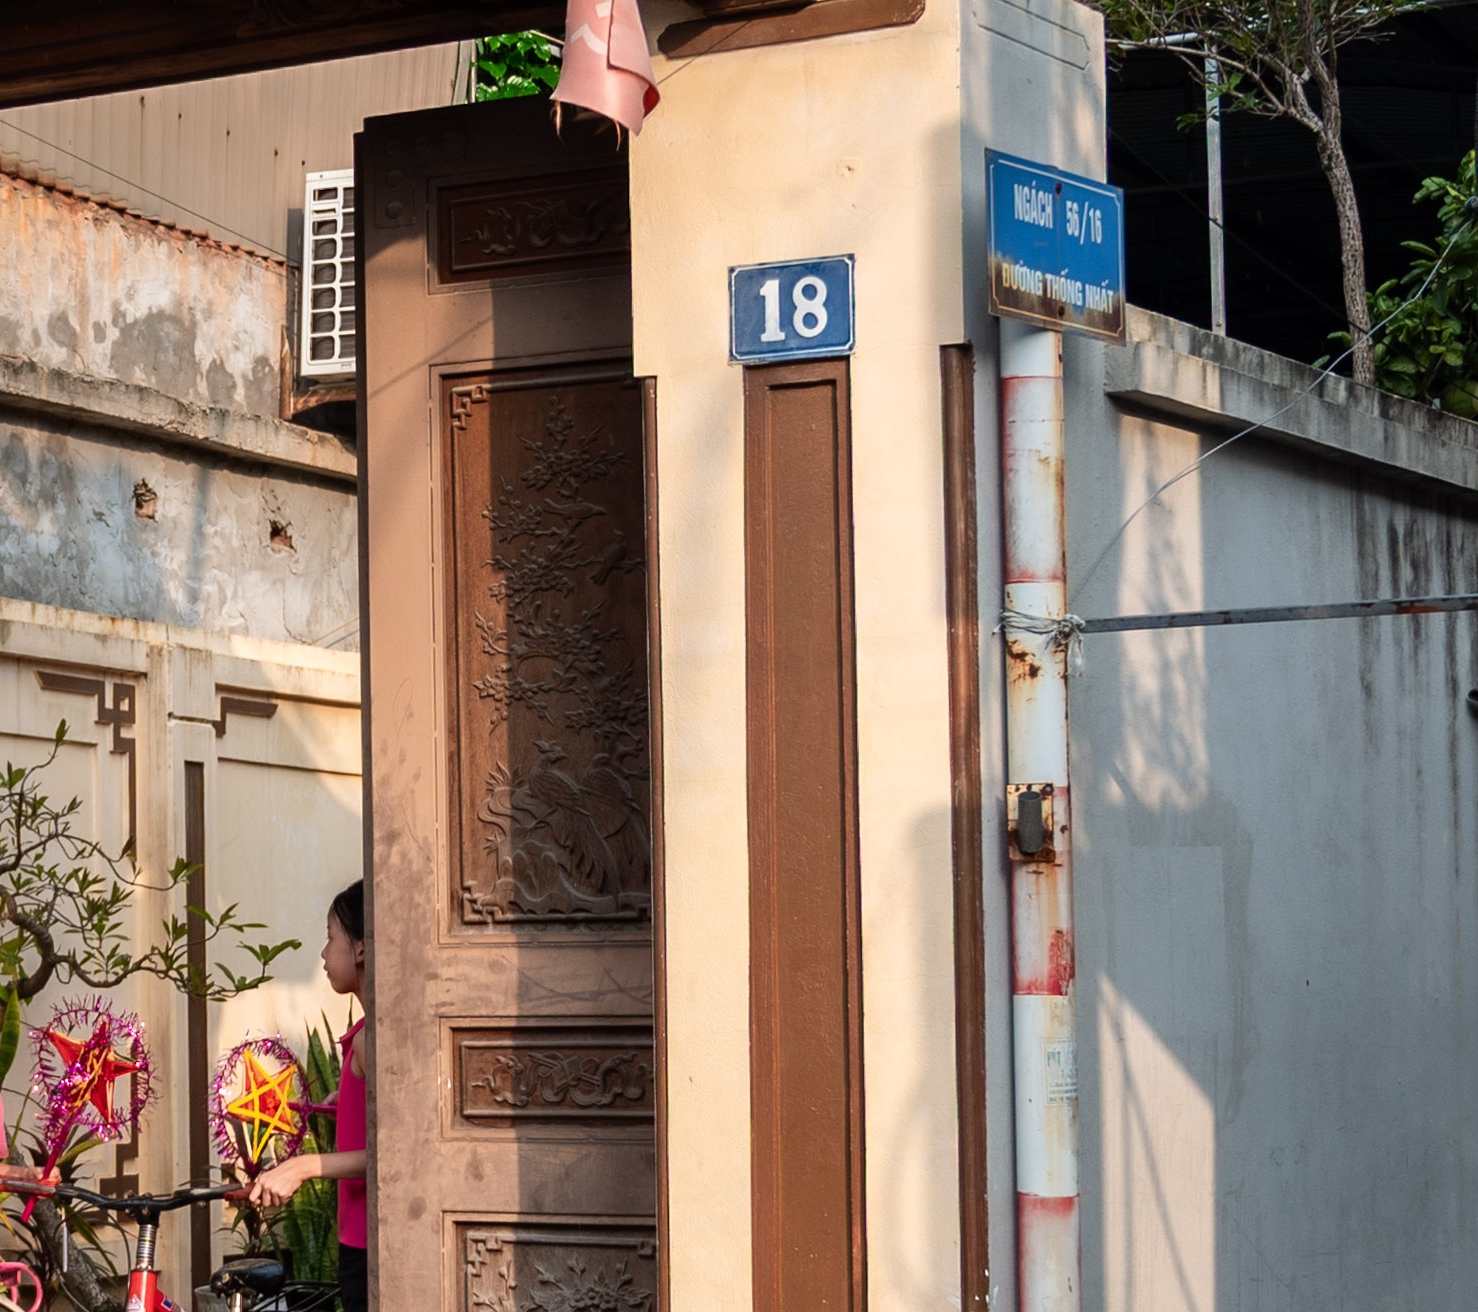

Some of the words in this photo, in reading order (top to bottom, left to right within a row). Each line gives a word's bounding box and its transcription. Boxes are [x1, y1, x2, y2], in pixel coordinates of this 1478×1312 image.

[1013, 179, 1054, 229] NGÁCH
[1066, 200, 1102, 245] 56/16
[759, 276, 828, 343] 18
[1002, 259, 1043, 297] ĐƯỜNG
[1045, 268, 1083, 306] THỐNG
[1085, 279, 1114, 314] NHẤT
